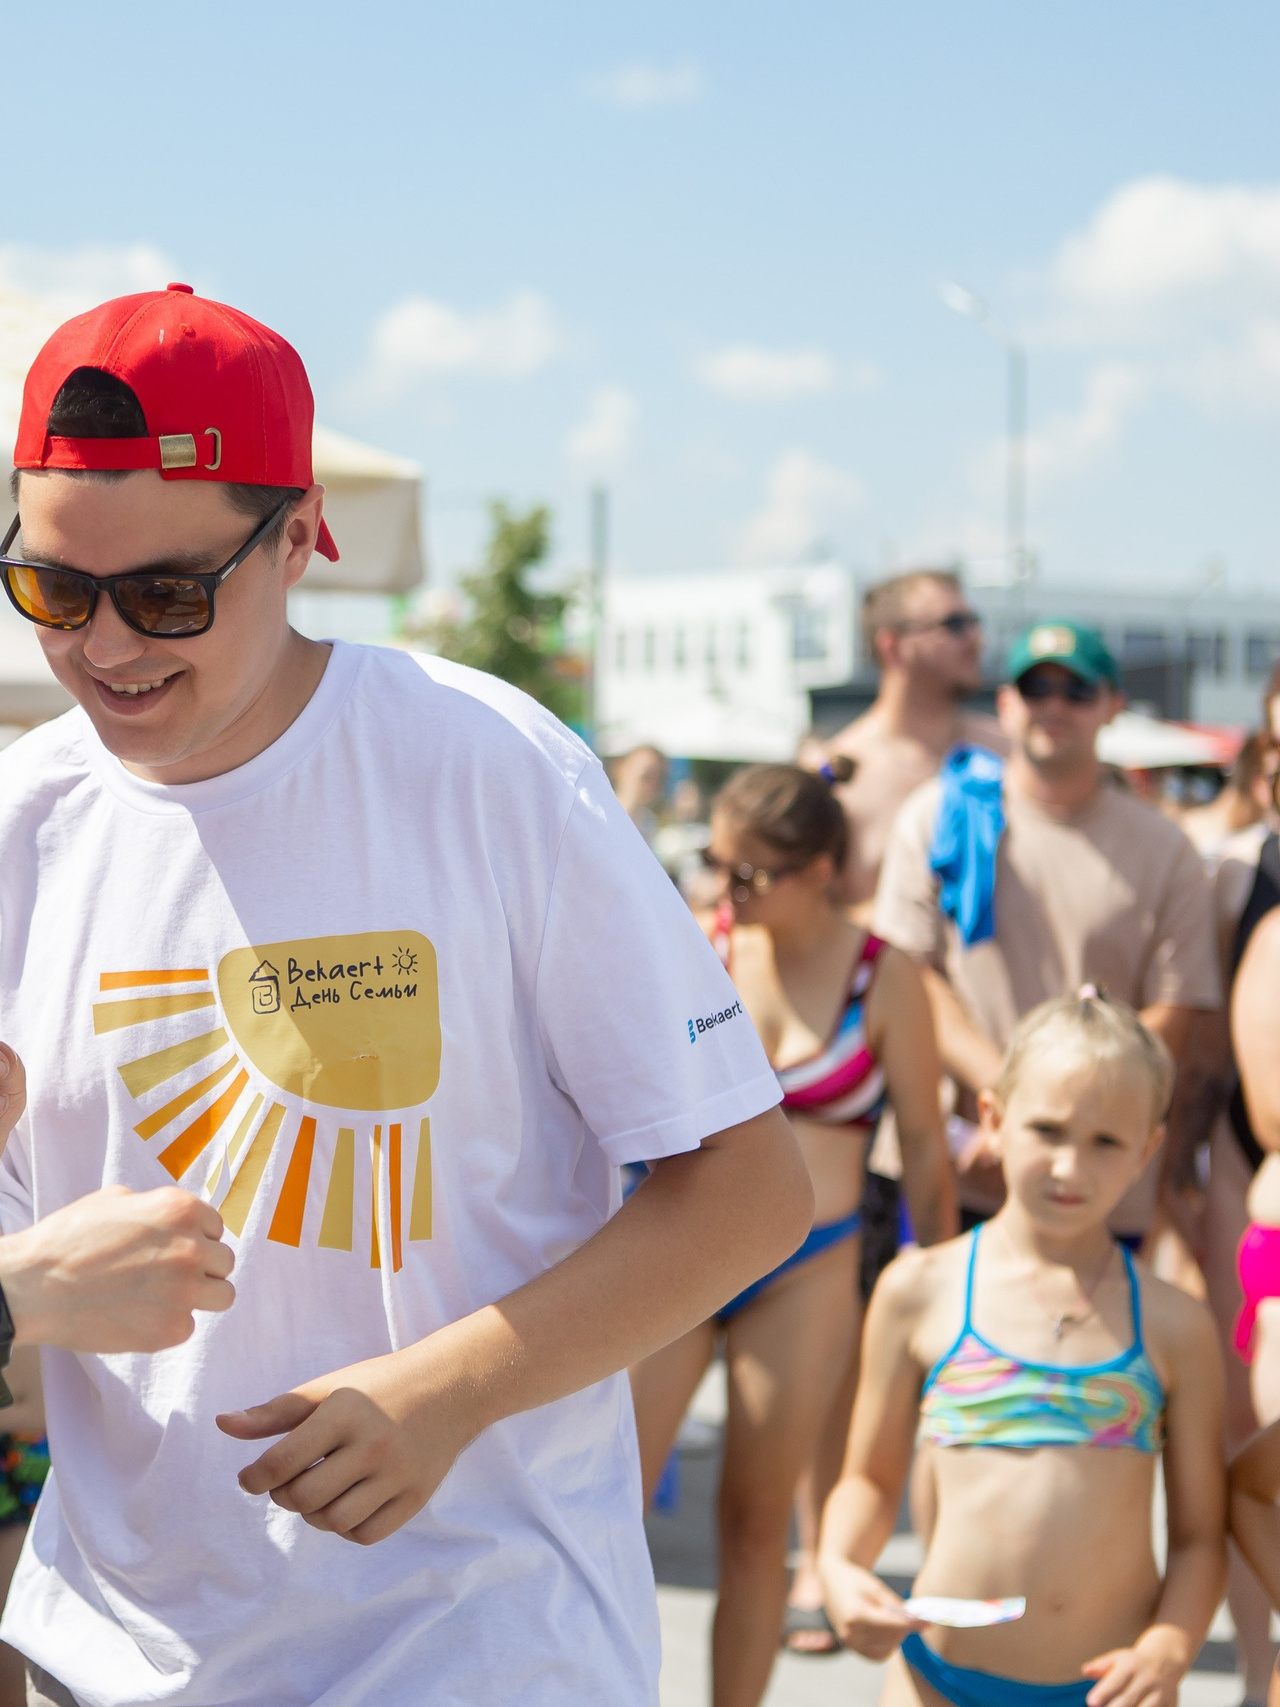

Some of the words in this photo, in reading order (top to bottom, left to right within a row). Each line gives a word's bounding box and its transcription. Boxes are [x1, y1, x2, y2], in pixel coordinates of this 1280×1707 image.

[287, 956, 384, 984] Bekaert
[290, 985, 341, 1012] День
[349, 980, 418, 1000] Семьи
[695, 1000, 743, 1034] Bekaert
